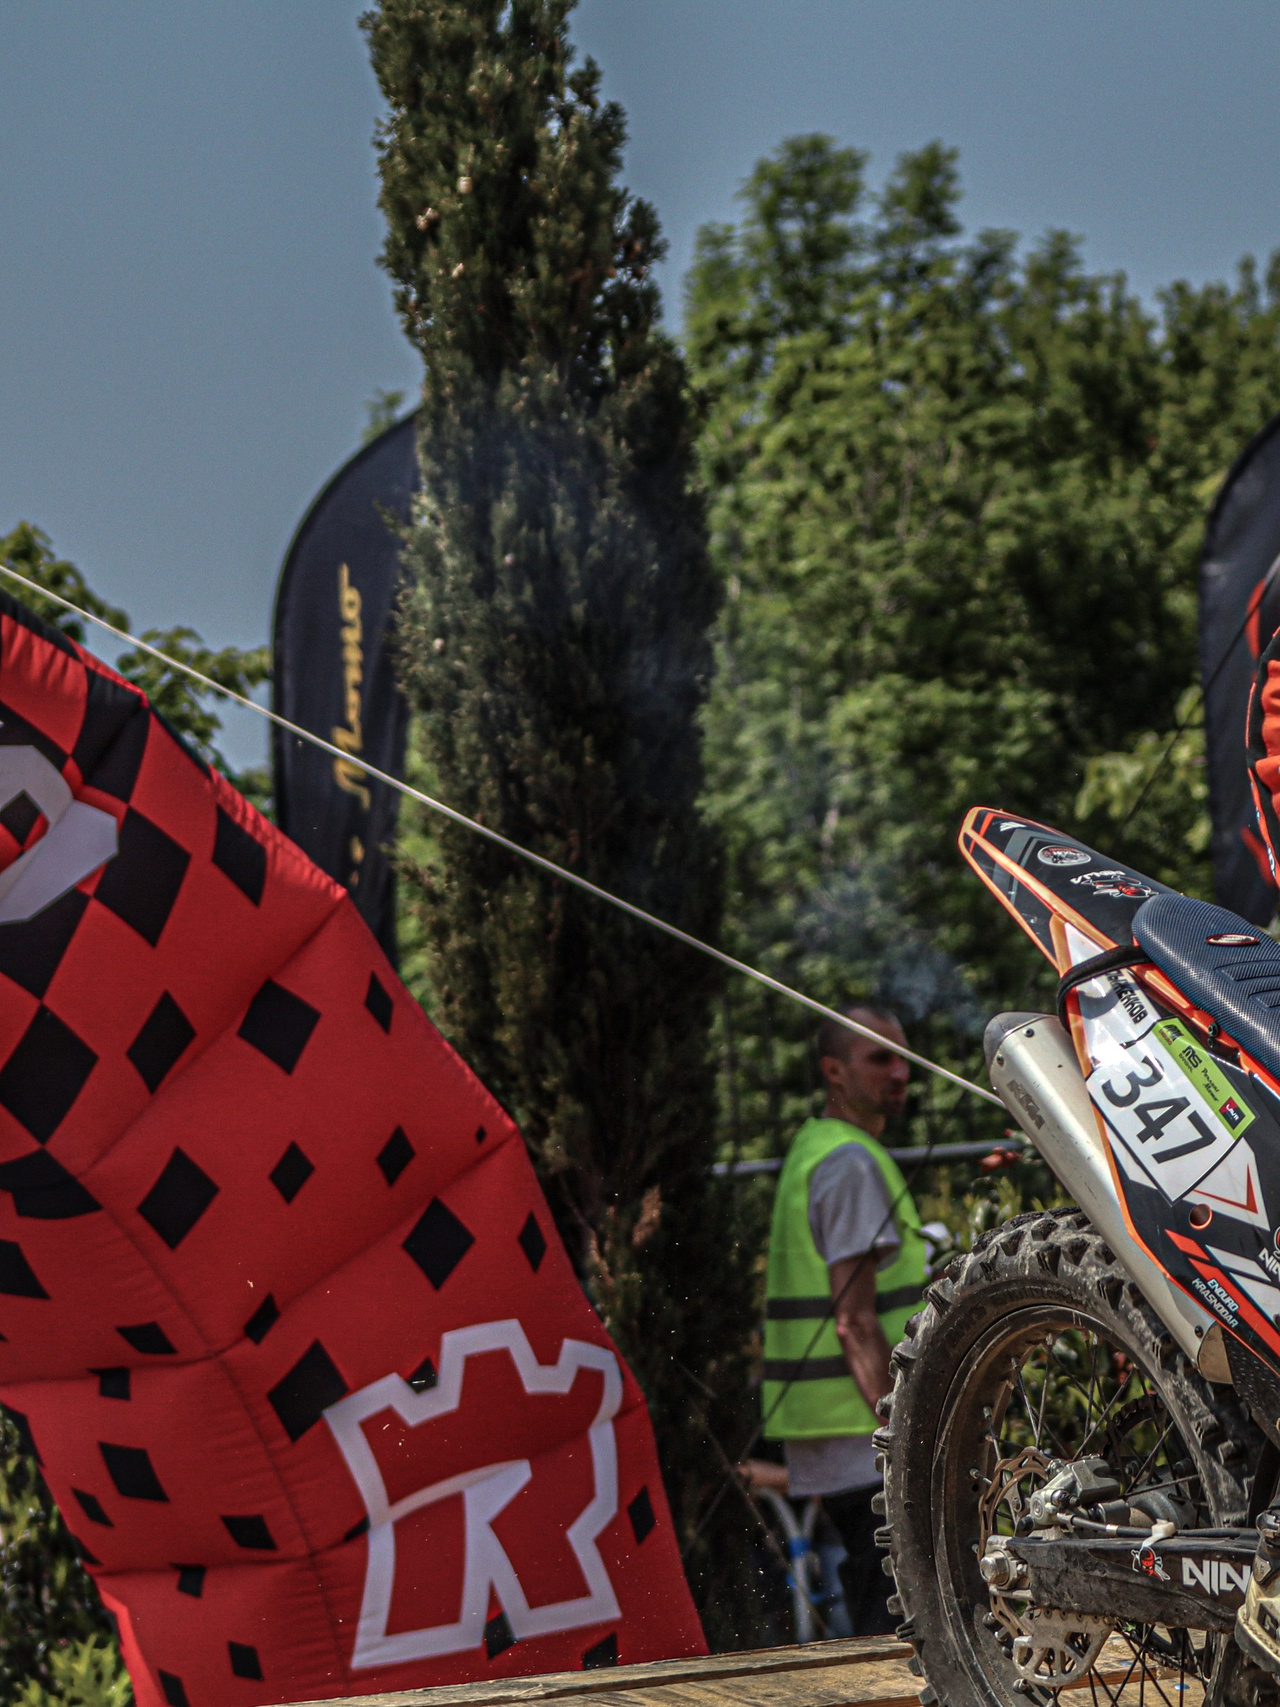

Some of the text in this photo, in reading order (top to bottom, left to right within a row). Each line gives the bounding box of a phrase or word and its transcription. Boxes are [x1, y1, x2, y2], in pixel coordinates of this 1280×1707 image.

[1101, 1055, 1217, 1165] 347
[1191, 1277, 1239, 1329] KRASNODAR
[1207, 1278, 1240, 1312] ENDURO
